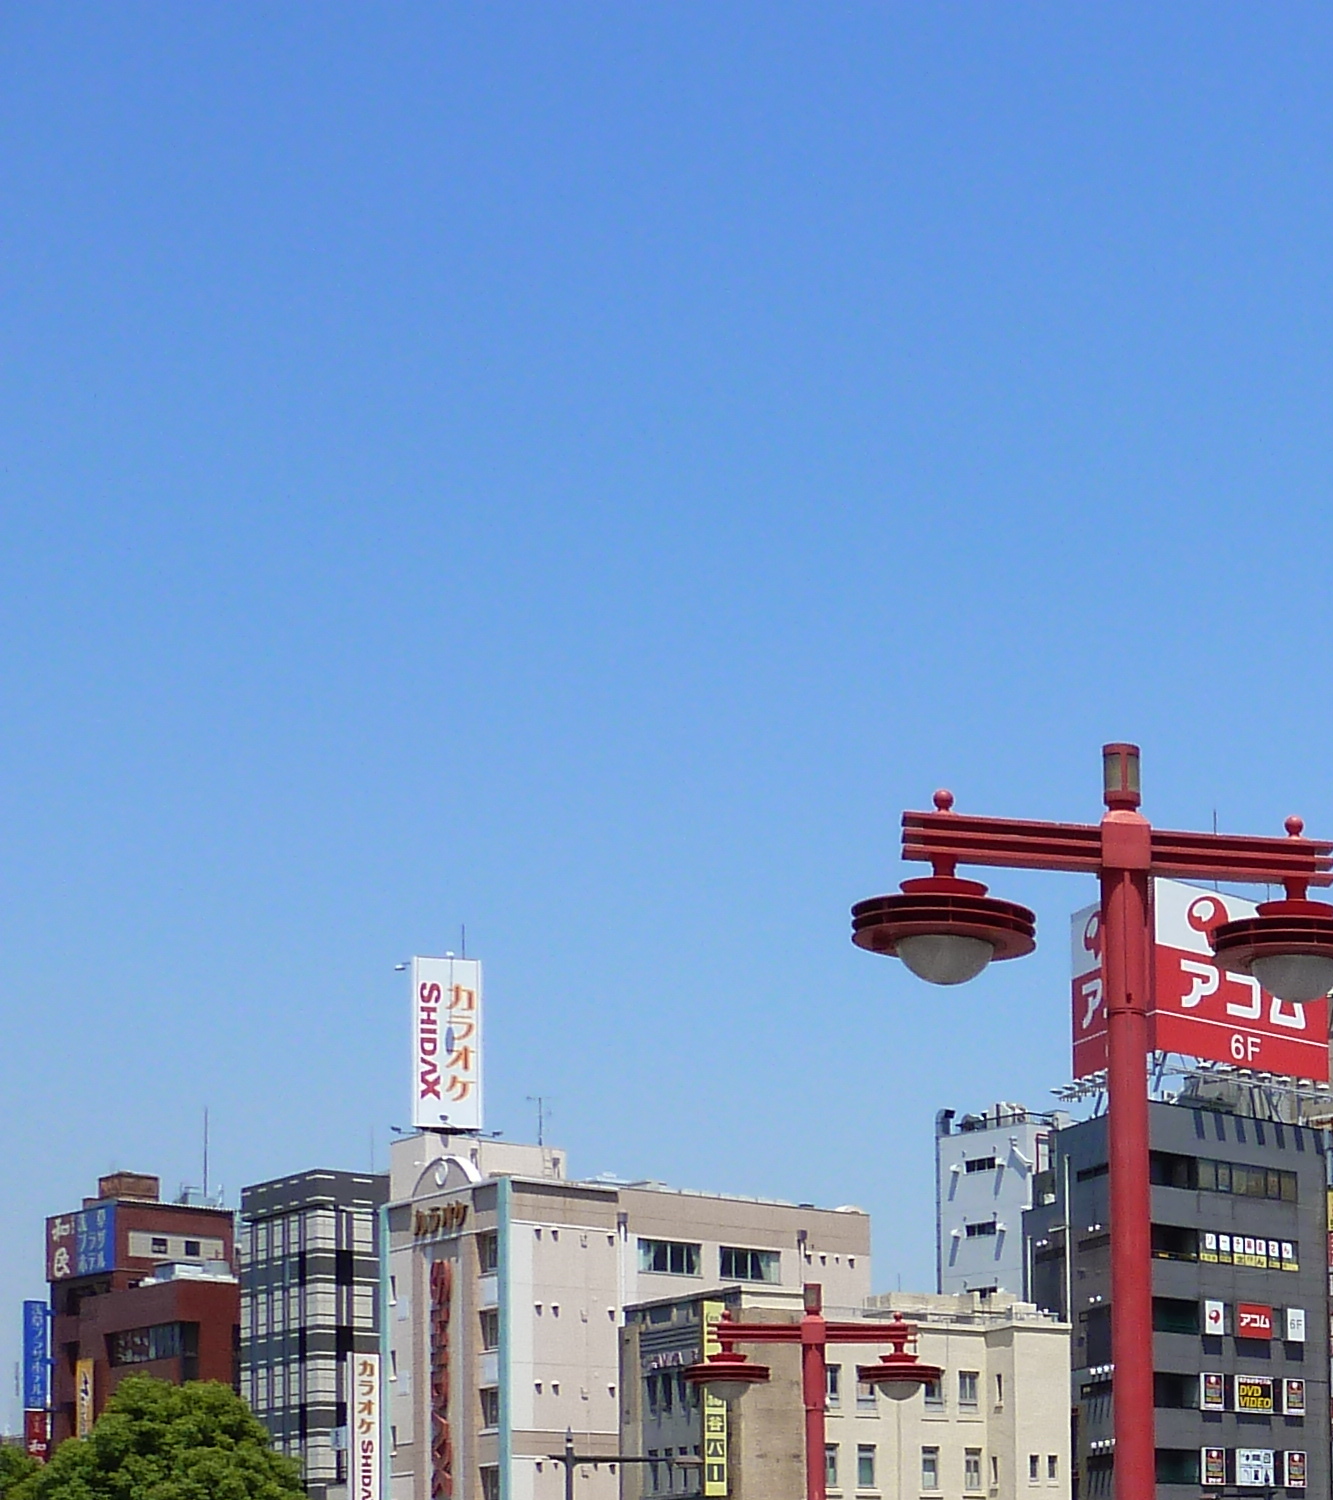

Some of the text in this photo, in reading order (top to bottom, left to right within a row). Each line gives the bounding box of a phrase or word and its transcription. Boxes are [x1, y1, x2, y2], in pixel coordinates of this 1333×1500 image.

[1180, 958, 1306, 1030] アコム
[419, 981, 442, 1101] SHIDAX
[447, 982, 475, 1103] カラオケ
[1230, 1034, 1262, 1061] 6F
[1239, 1314, 1270, 1328] アコム
[1290, 1319, 1303, 1331] 6F
[357, 1360, 376, 1435] カラオケ
[1239, 1384, 1262, 1397] DVD
[1239, 1396, 1272, 1409] VIDEO
